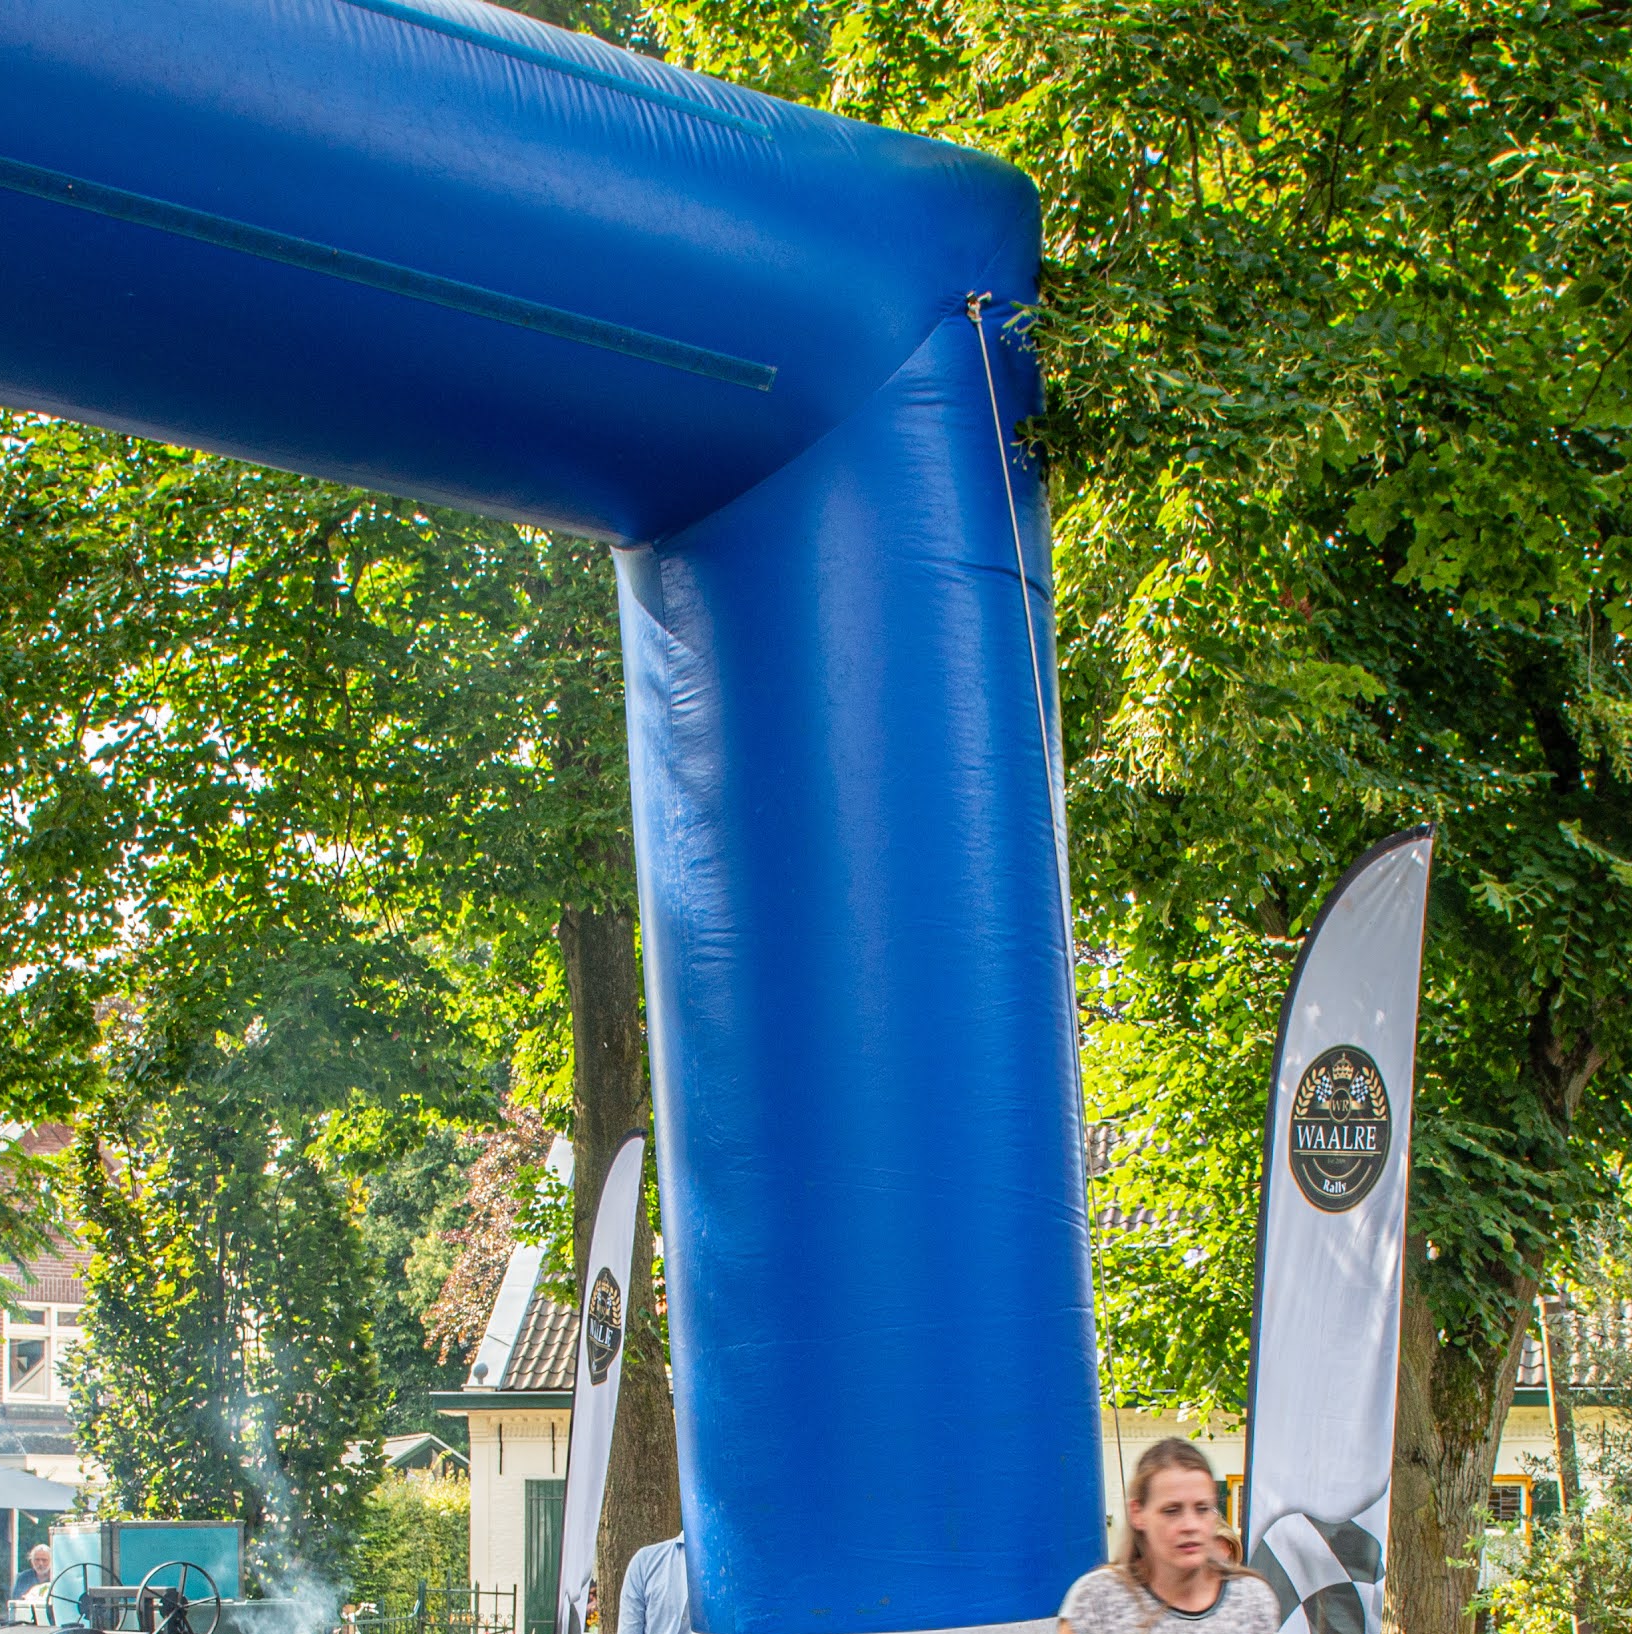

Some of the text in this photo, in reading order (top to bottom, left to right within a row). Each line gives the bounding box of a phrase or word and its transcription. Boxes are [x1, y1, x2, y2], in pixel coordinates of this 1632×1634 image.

[1331, 1099, 1350, 1112] WR
[1296, 1125, 1377, 1151] WAALRE
[1323, 1178, 1348, 1196] Rally
